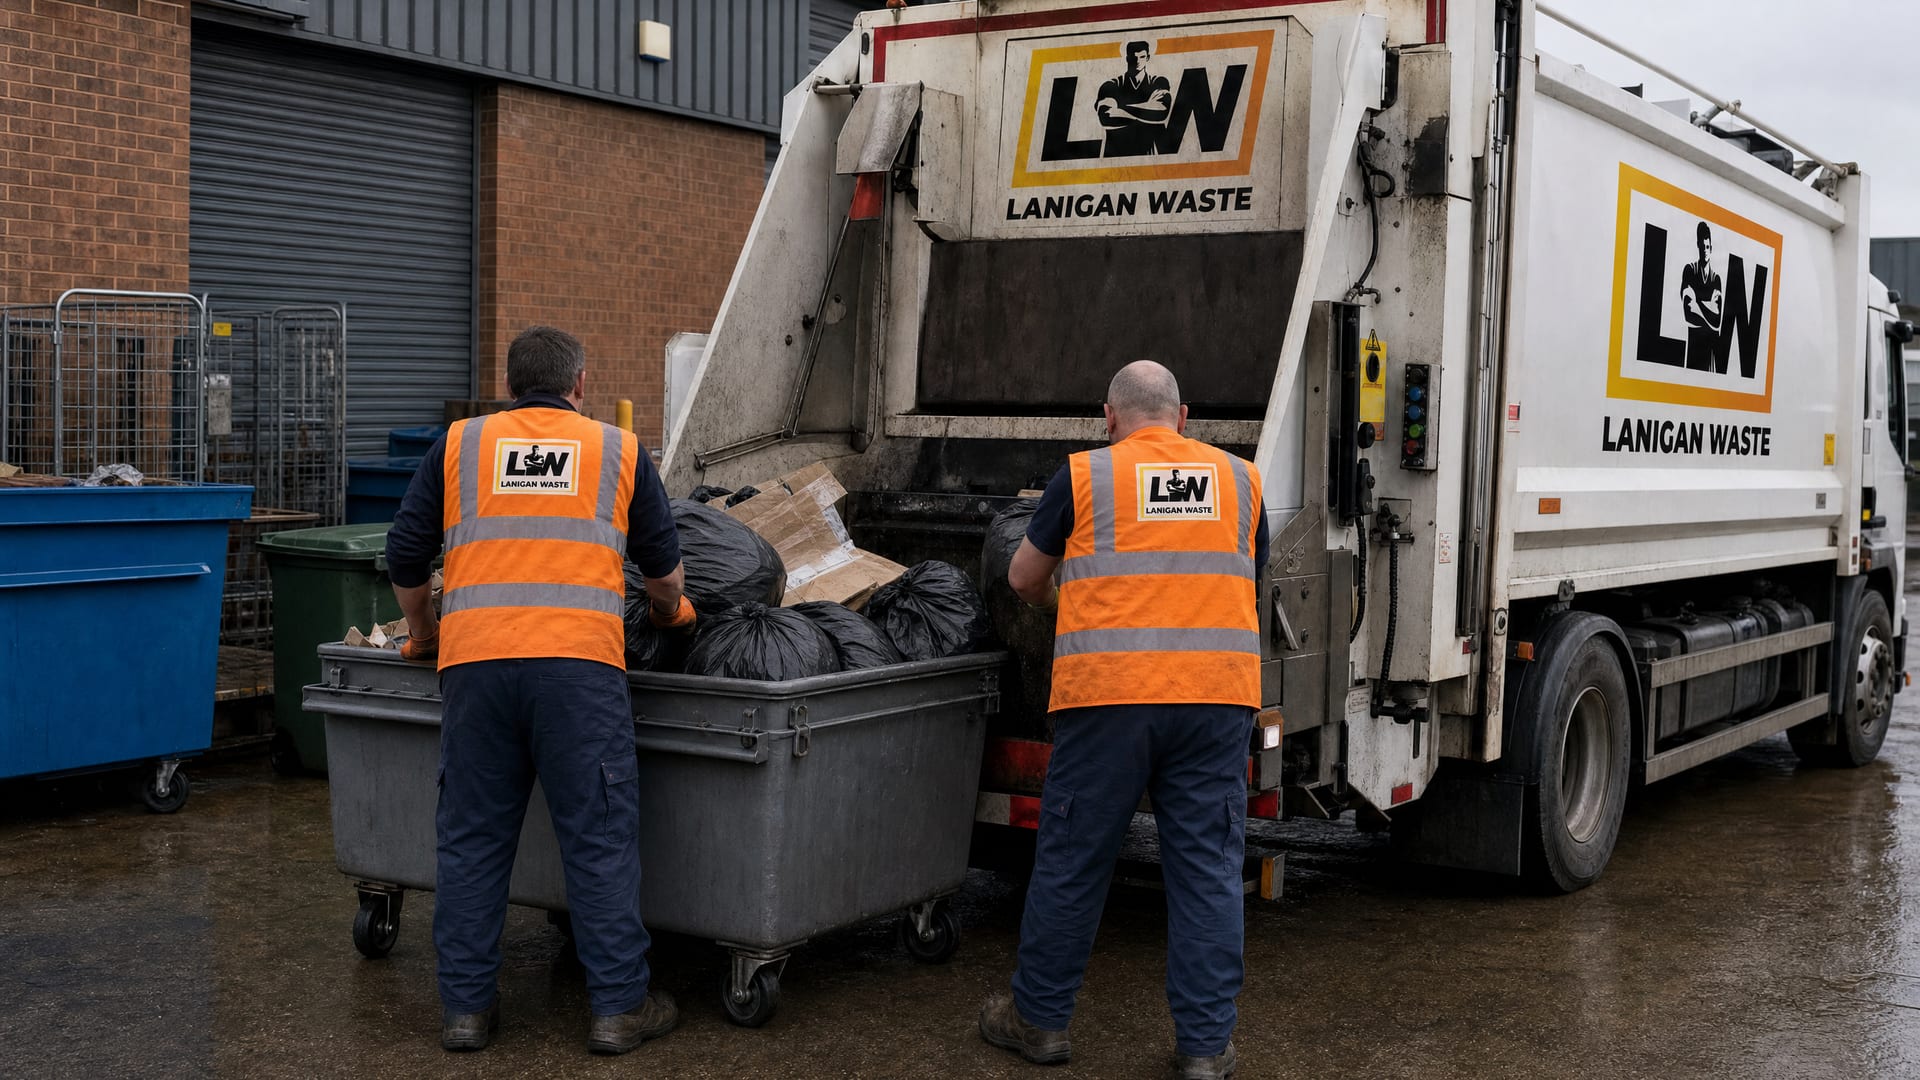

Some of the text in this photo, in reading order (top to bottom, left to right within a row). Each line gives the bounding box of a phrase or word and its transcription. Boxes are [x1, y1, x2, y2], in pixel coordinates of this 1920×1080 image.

[1006, 186, 1253, 221] LANIGAN WASTE
[1602, 416, 1771, 456] LANIGAN WASTE
[500, 480, 570, 489] LANIGAN WASTE
[1145, 506, 1213, 514] LANIGAN WASTE
